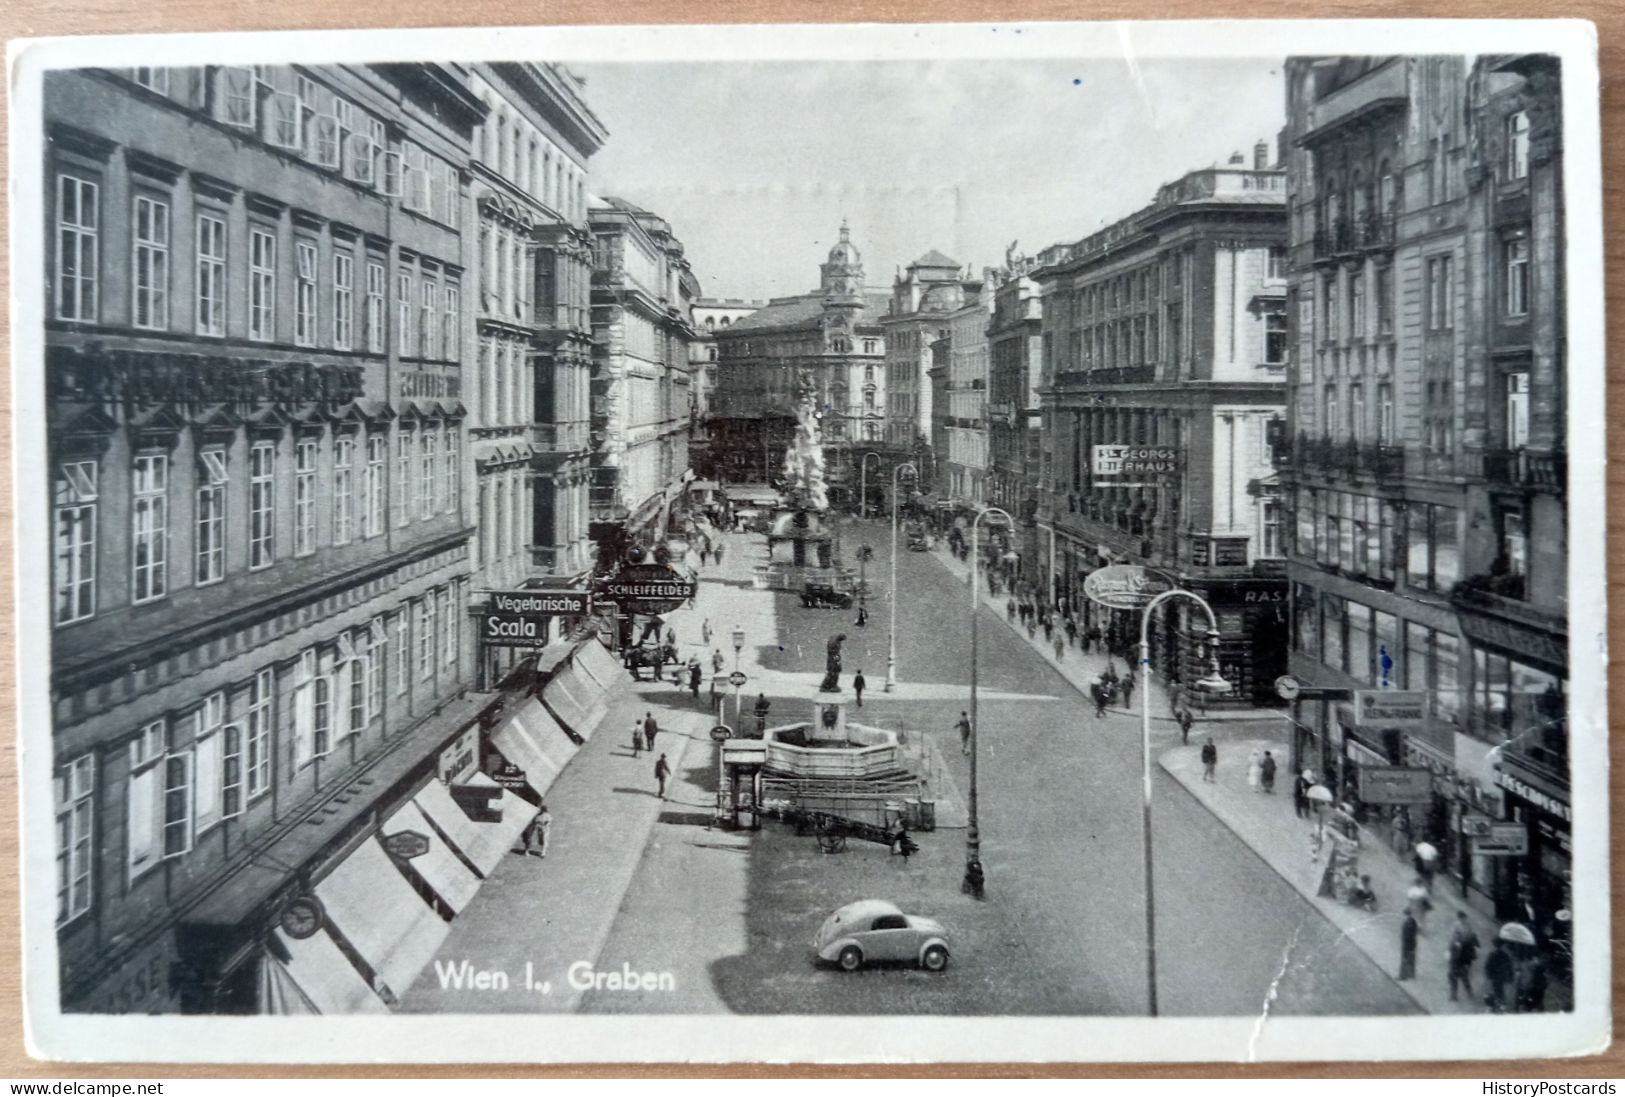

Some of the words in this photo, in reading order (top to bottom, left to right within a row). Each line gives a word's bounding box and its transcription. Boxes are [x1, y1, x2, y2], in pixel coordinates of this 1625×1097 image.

[1120, 449, 1175, 459] GEORGS
[1099, 461, 1175, 472] BIERHAUS
[607, 584, 692, 596] SCHLEIFFELDER
[495, 595, 582, 613] Vegetarische
[488, 616, 536, 637] Scala
